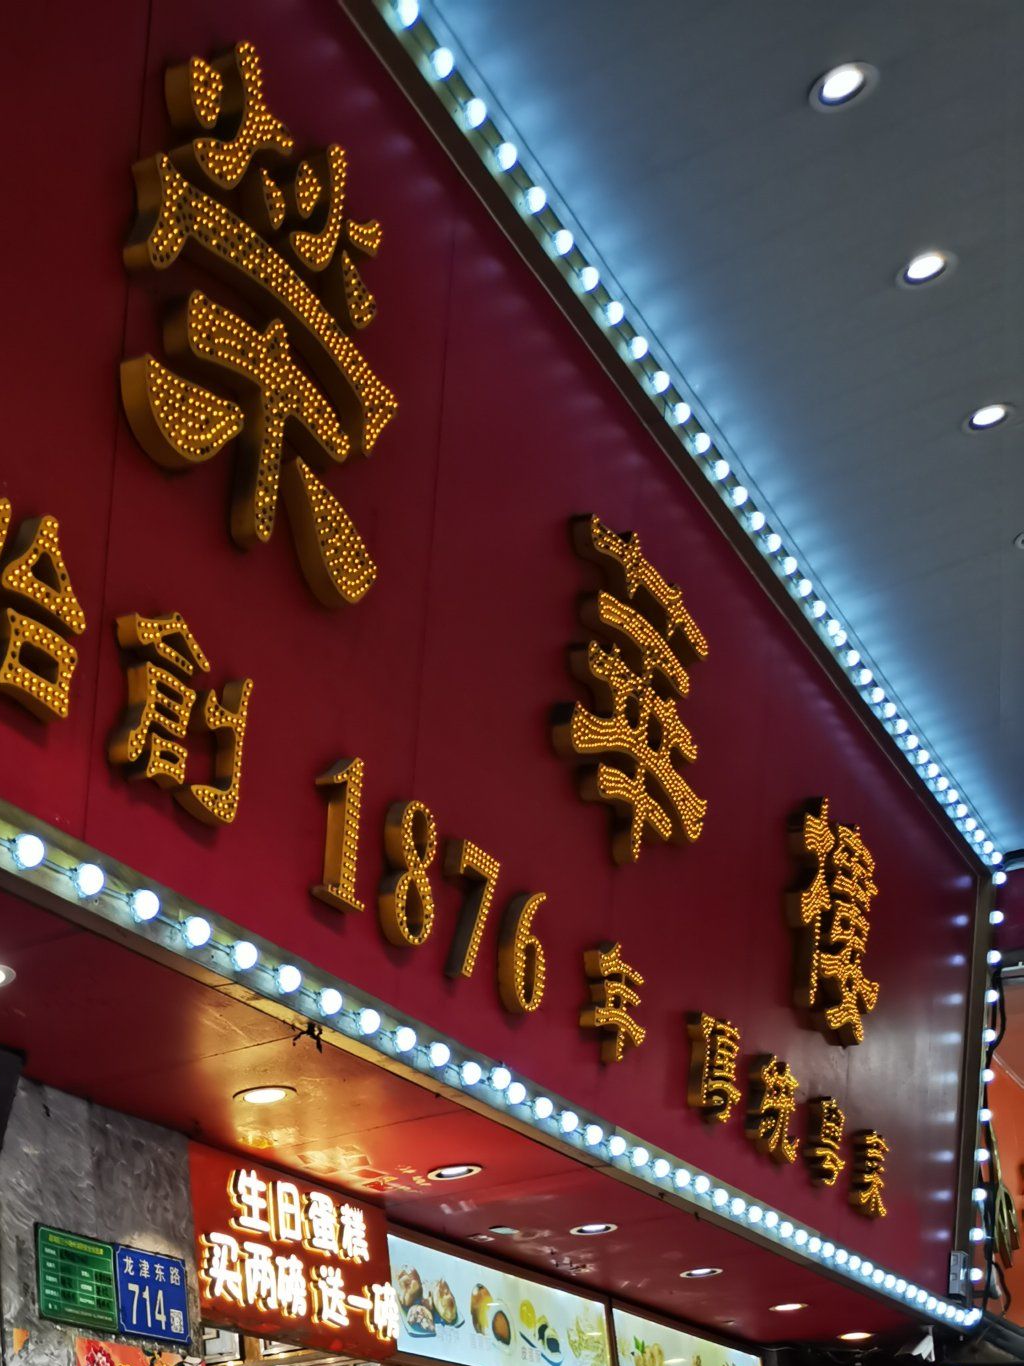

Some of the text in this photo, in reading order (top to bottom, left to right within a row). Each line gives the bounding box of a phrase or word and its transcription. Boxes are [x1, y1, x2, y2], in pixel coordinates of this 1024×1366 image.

[229, 1169, 370, 1262] 生日蛋糕
[123, 1256, 181, 1286] 龙津东路
[199, 1232, 399, 1341] 买两磅送一磅
[128, 1284, 167, 1330] 714
